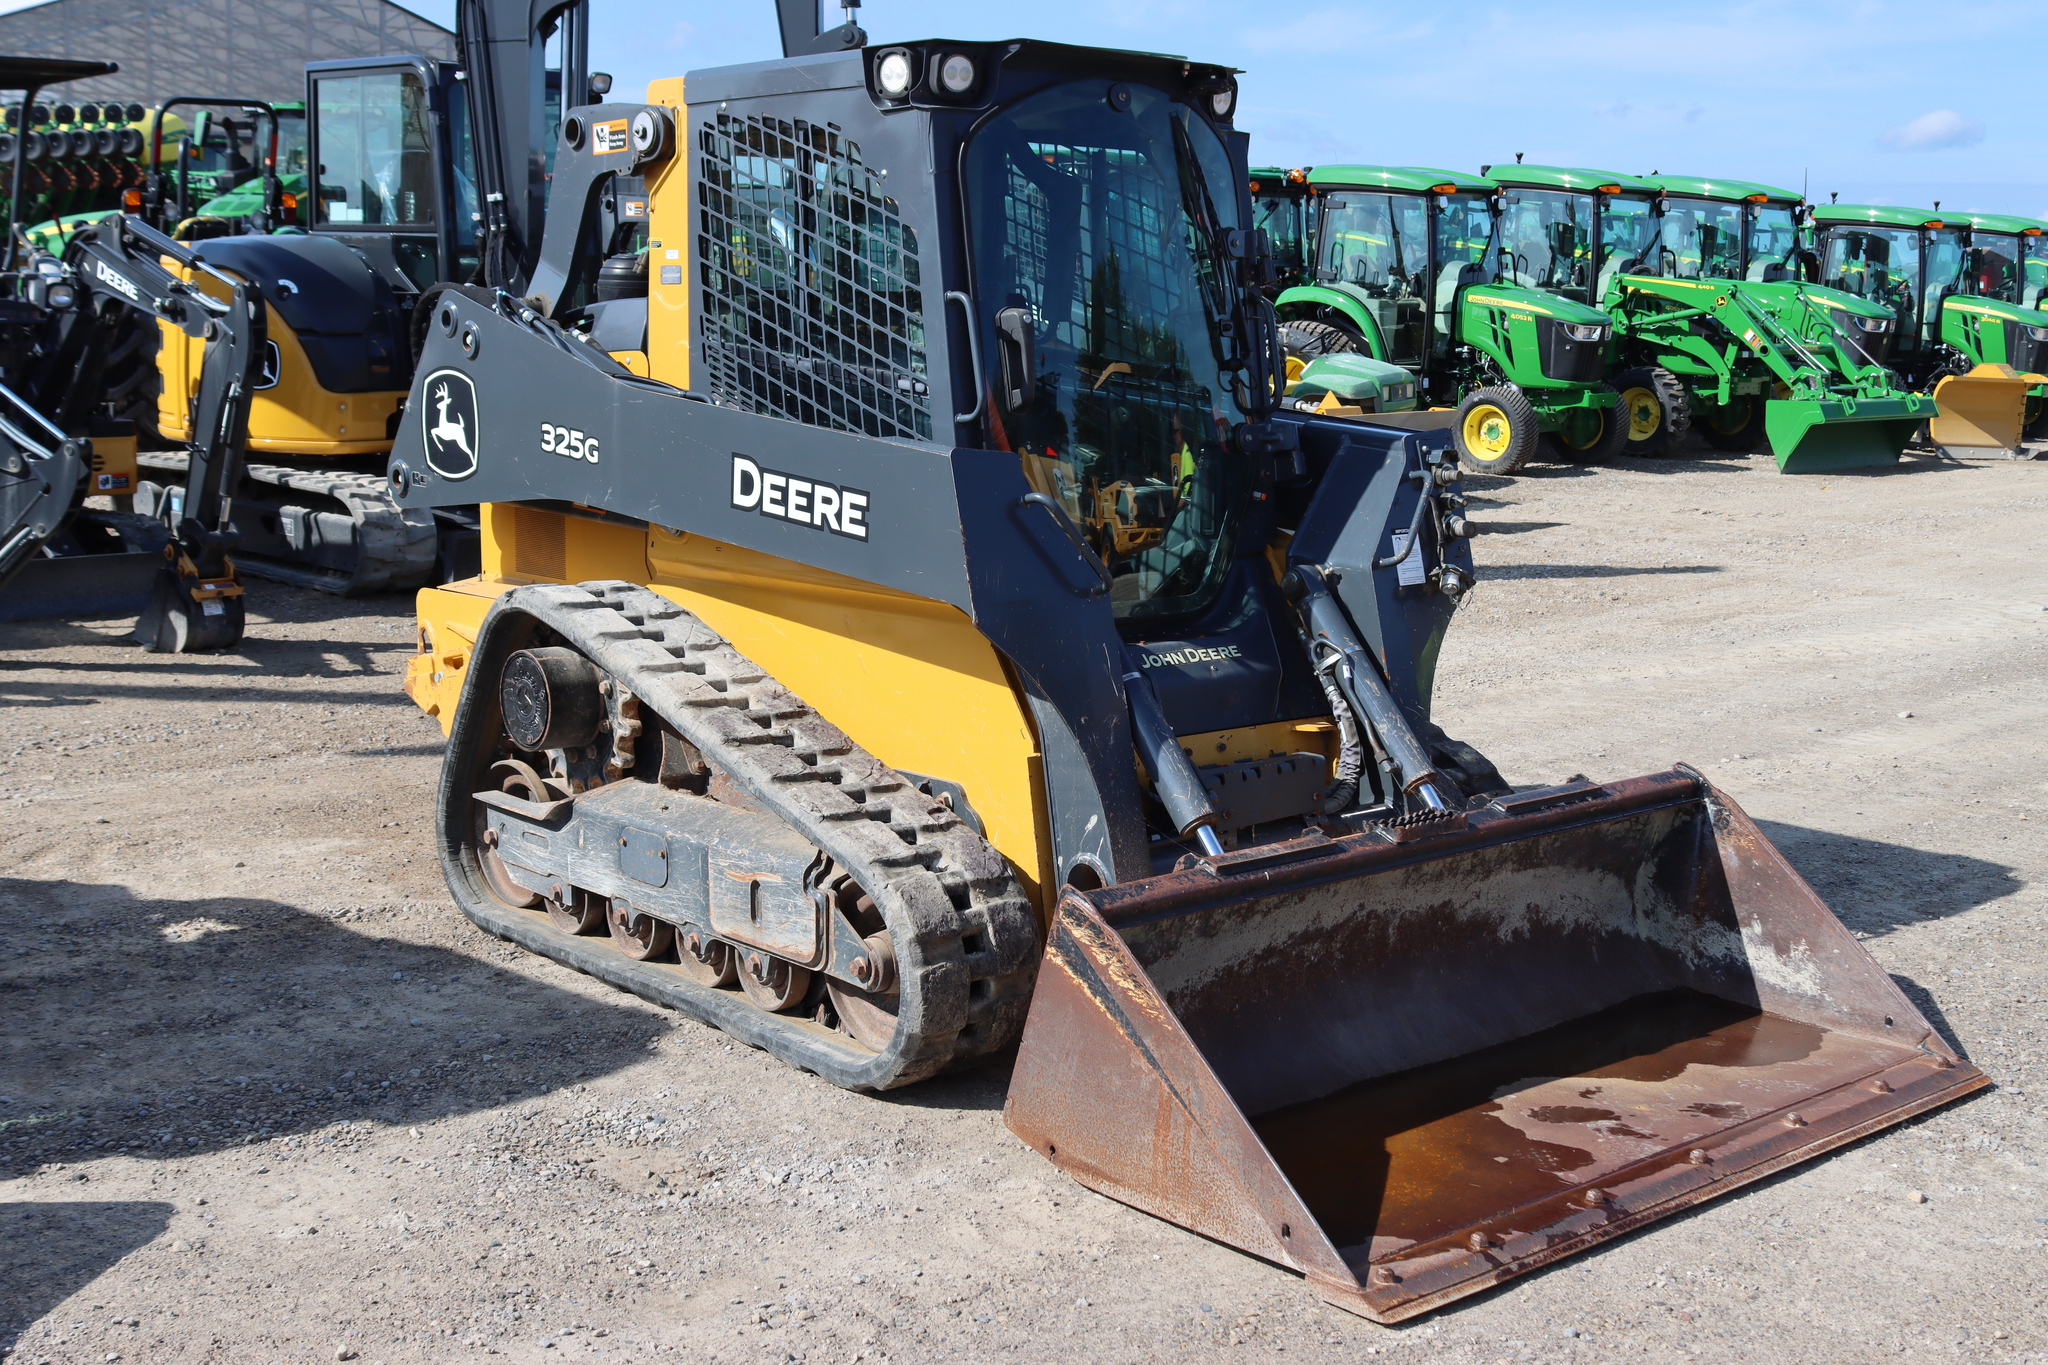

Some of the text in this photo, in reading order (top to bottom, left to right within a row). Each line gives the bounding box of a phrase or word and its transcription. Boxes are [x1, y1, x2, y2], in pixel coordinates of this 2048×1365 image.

[96, 260, 139, 301] DEERE
[1470, 296, 1505, 306] JOHN DEERE
[540, 423, 600, 464] 325G
[732, 456, 868, 539] DEERE
[1141, 645, 1242, 669] JOHN DEERE
